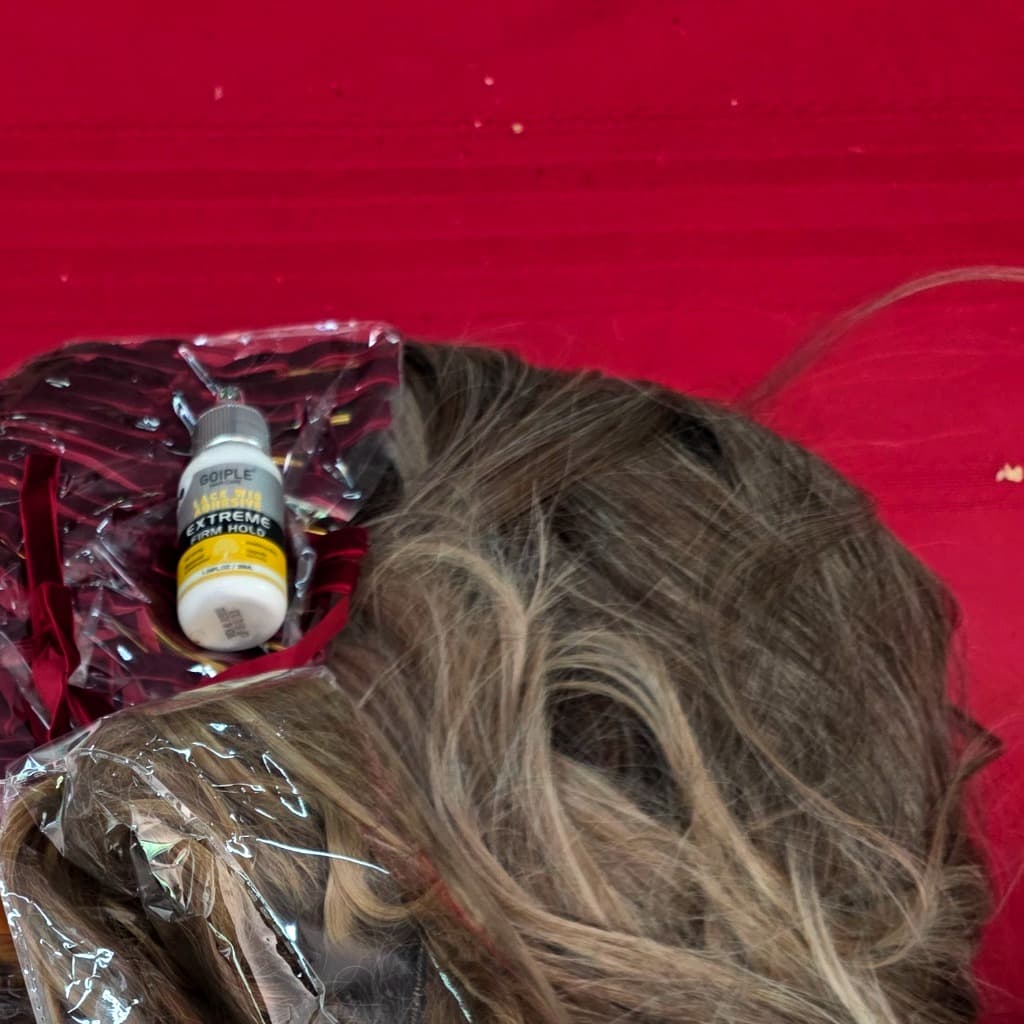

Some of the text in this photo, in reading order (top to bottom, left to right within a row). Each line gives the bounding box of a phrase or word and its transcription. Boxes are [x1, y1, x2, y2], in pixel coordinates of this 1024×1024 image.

[200, 469, 253, 486] GOIPLE
[186, 511, 271, 537] EXTREME
[190, 524, 267, 545] FIRM HOLD
